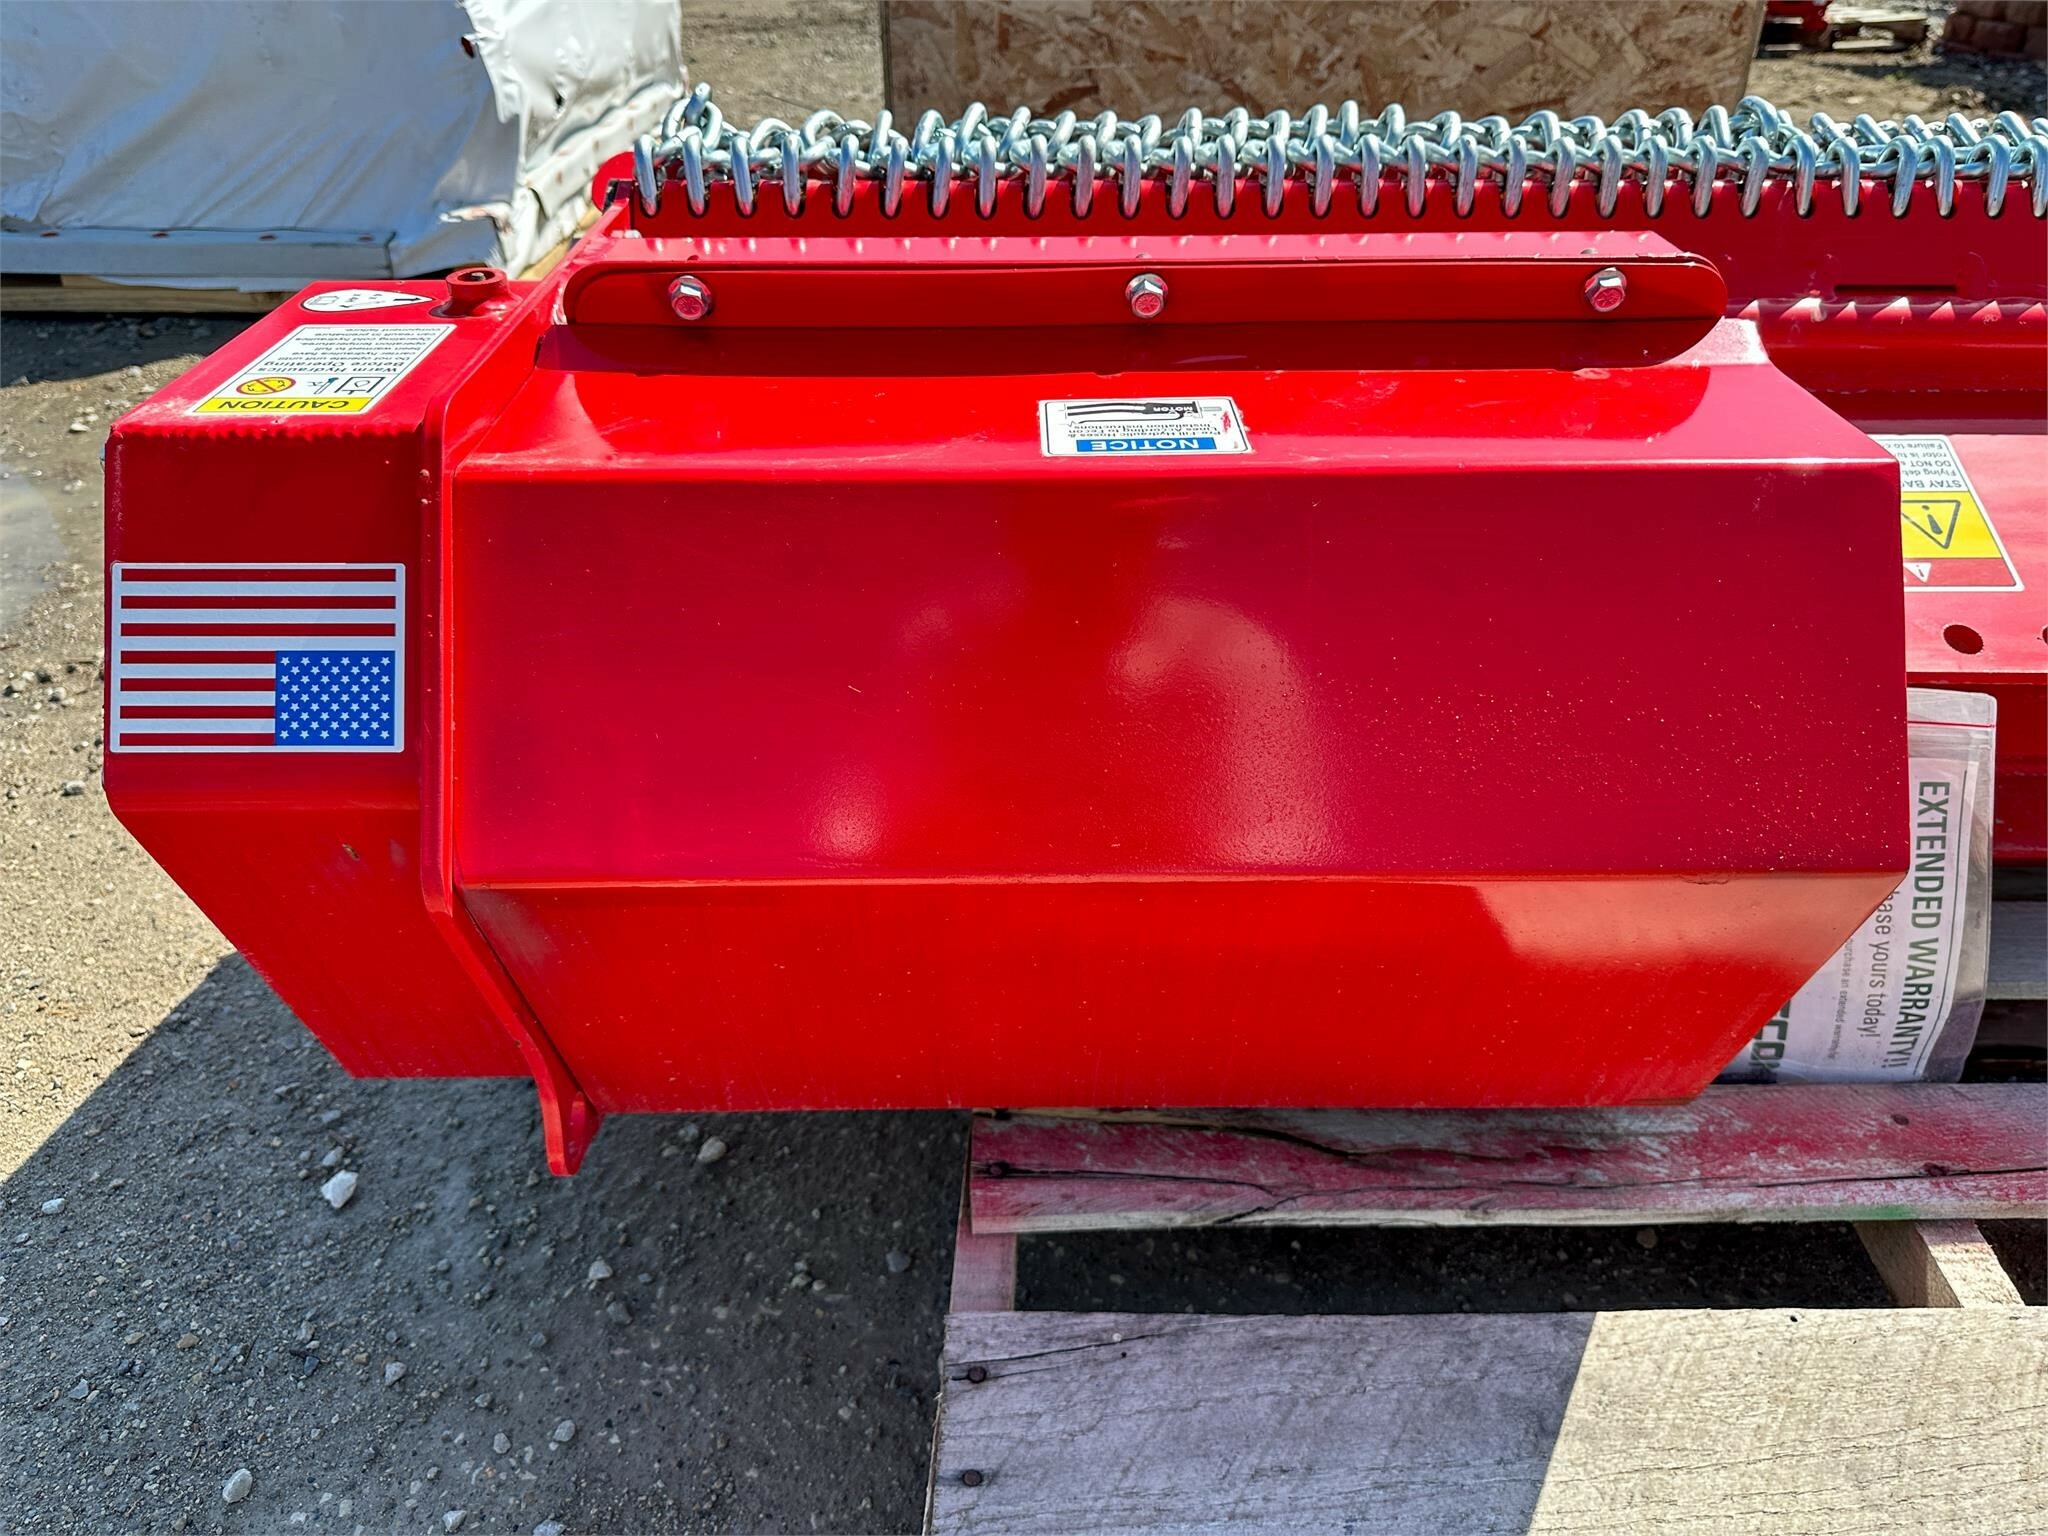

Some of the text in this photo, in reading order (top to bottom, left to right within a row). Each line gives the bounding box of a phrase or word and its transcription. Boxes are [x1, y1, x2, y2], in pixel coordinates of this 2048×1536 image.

[217, 400, 350, 409] CAUTION
[1090, 439, 1201, 451] NOTICE
[1923, 468, 1957, 476] Flying
[1930, 480, 1962, 488] STAY
[1881, 781, 1951, 1069] EXTENDED WARRANTY!!
[1868, 941, 1891, 989] yours
[1840, 979, 1850, 989] an
[1834, 990, 1849, 1023] extended
[1856, 993, 1887, 1037] today!
